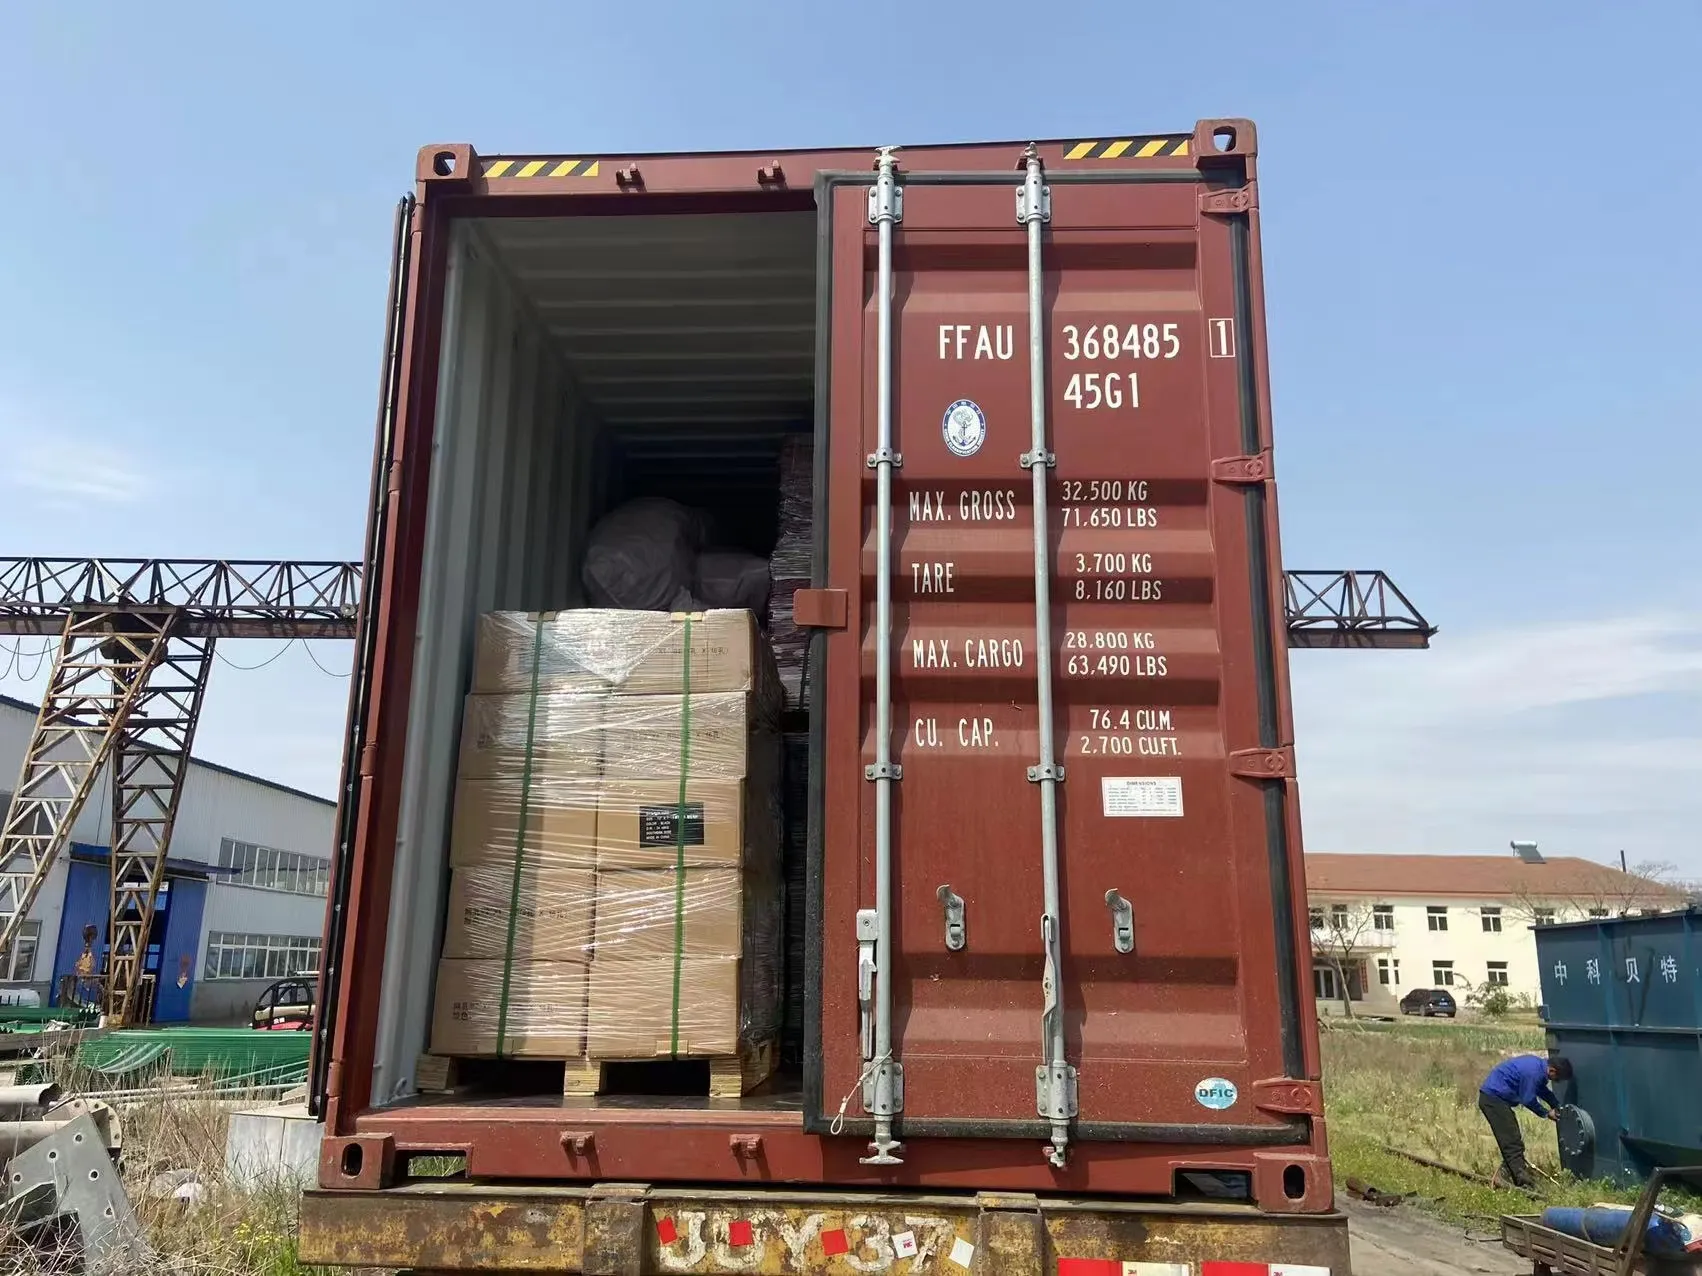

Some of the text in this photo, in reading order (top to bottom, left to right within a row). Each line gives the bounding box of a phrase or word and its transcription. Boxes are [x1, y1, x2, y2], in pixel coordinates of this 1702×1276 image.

[939, 320, 1228, 360] FFAU 368485 1
[1064, 372, 1139, 408] 45G1
[1062, 481, 1148, 501] 32,500 KG
[909, 490, 1015, 521] MAX. GROSS
[1061, 508, 1157, 527] 71,650 LBS
[1075, 553, 1152, 573] 3,700 KG
[911, 563, 954, 593] TARE
[1075, 580, 1162, 600] 8,160 LBS
[1066, 631, 1155, 649] 28,800 KG
[913, 639, 1023, 668] MAX. CARGO
[1068, 655, 1168, 676] 63,490 LBS
[1090, 709, 1175, 731] 76.4 CU.M.
[915, 718, 999, 747] CU. CAP.
[1080, 736, 1132, 754] 2,700
[1554, 955, 1678, 986] 中科贝特
[1199, 1088, 1234, 1098] DFIC
